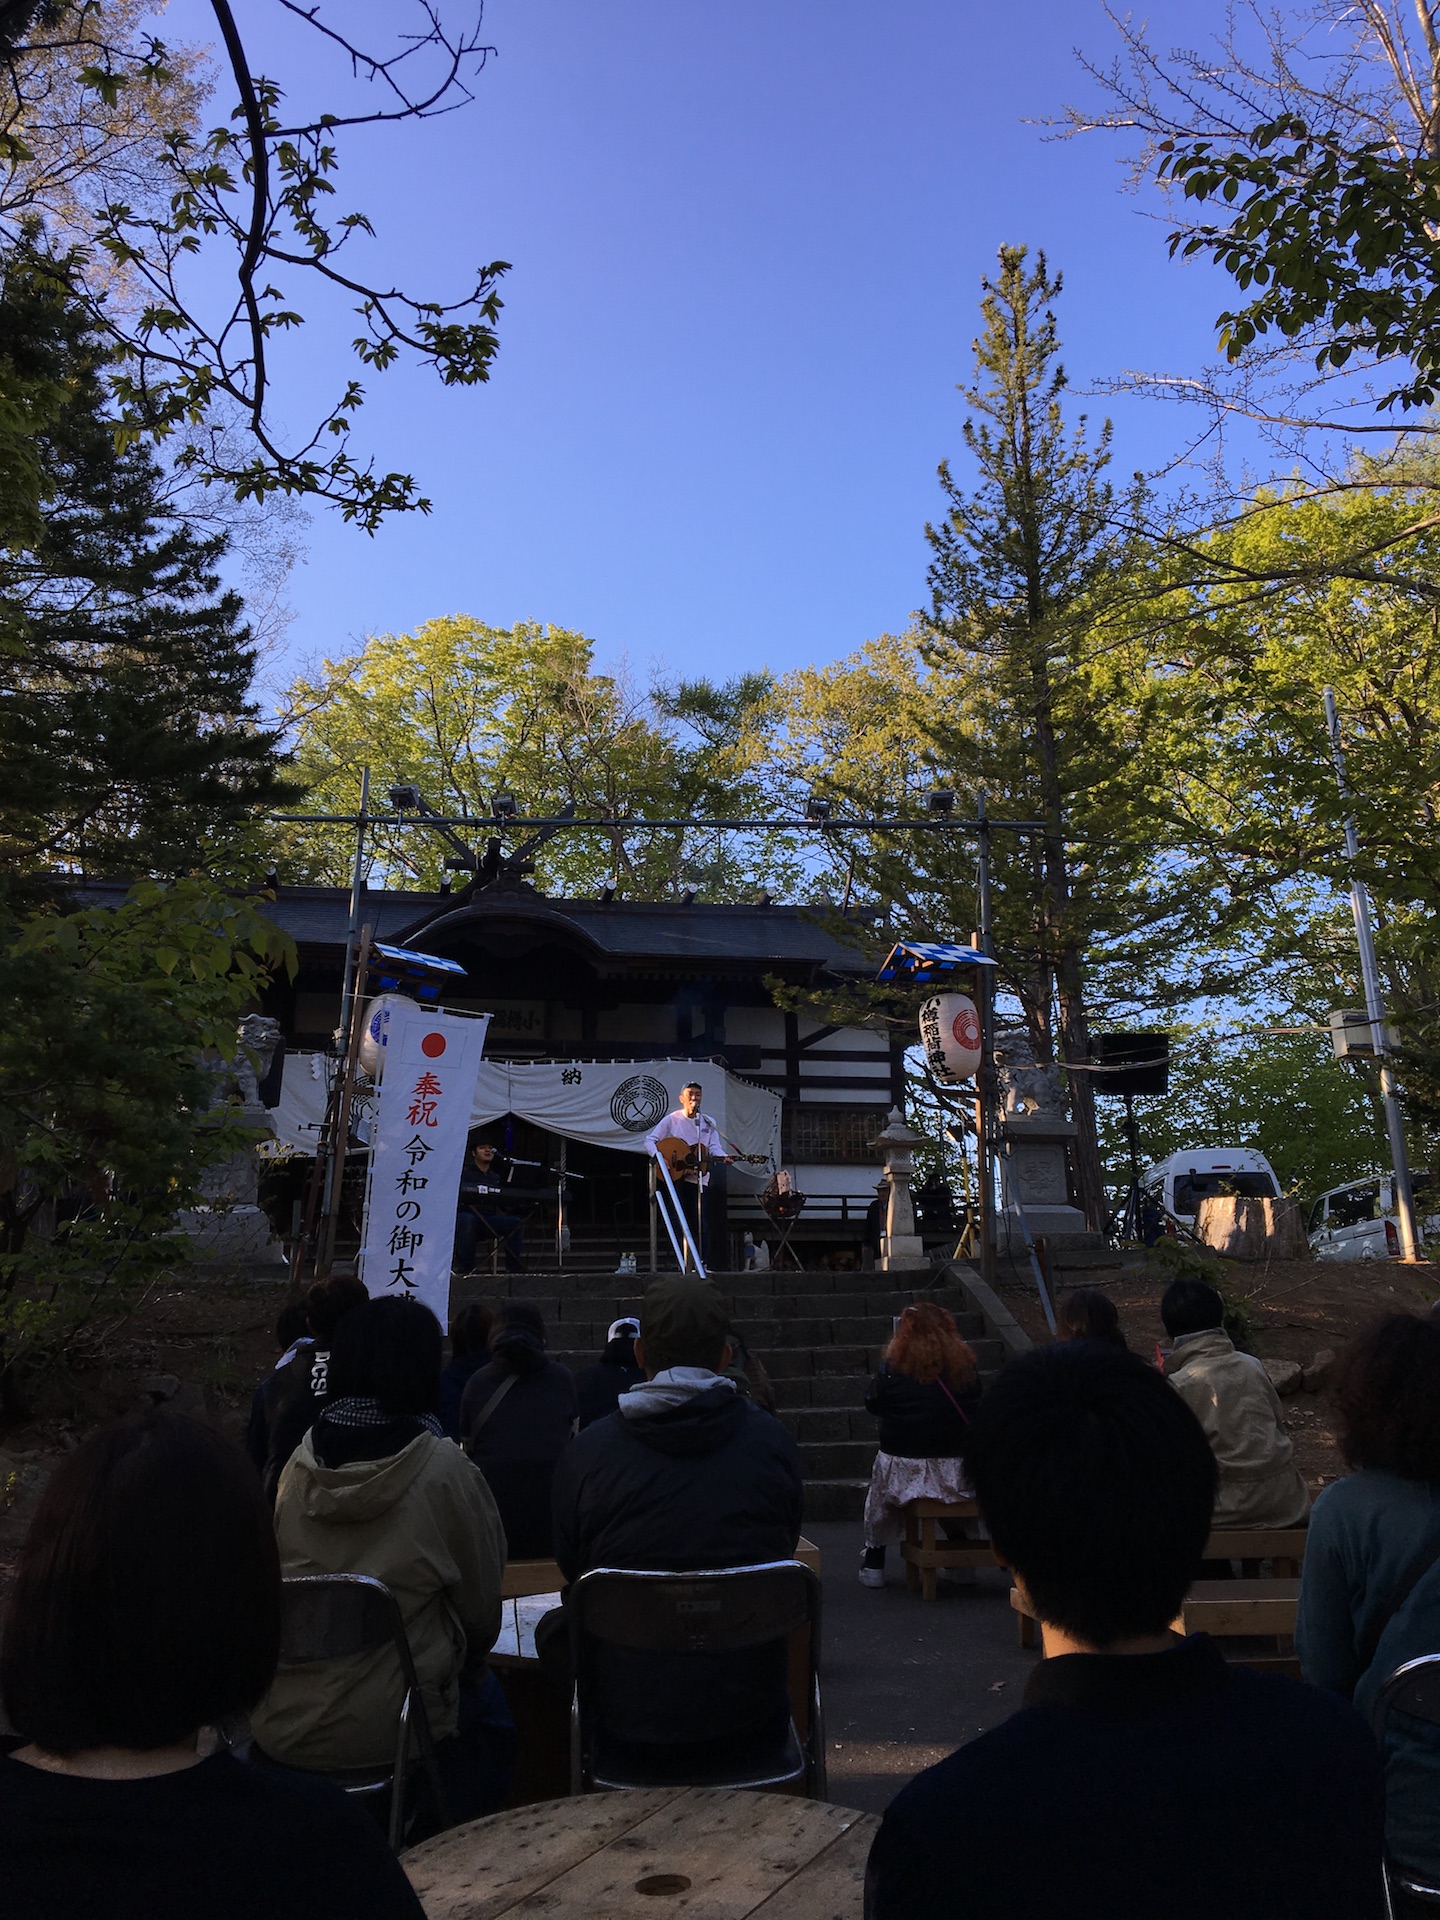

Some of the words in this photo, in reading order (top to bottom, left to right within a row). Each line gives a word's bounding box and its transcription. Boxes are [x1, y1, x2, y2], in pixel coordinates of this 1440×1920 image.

[561, 1067, 582, 1087] 納
[386, 1072, 442, 1301] 奉祝令和の御大
